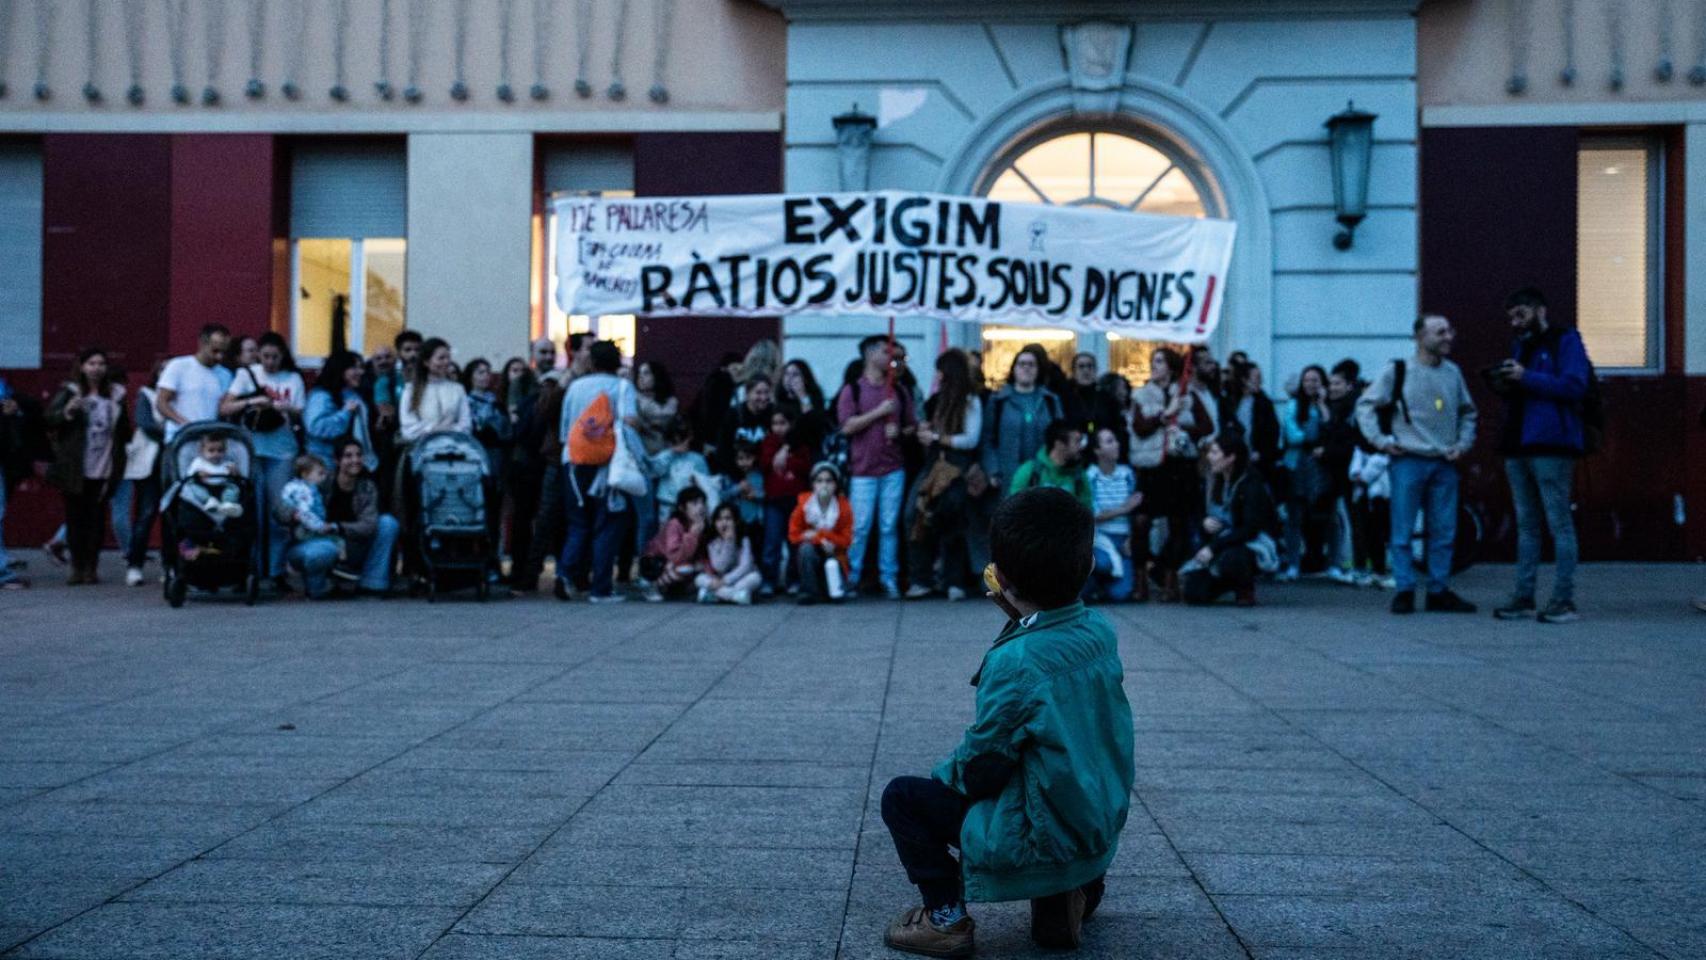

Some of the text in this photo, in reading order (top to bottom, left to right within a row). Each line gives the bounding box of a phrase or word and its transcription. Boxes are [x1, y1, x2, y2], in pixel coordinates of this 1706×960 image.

[783, 196, 1001, 250] EXIGIM
[640, 251, 837, 312] RÀTIOS
[845, 251, 985, 310] JUSTES,
[987, 257, 1072, 315] SOUS
